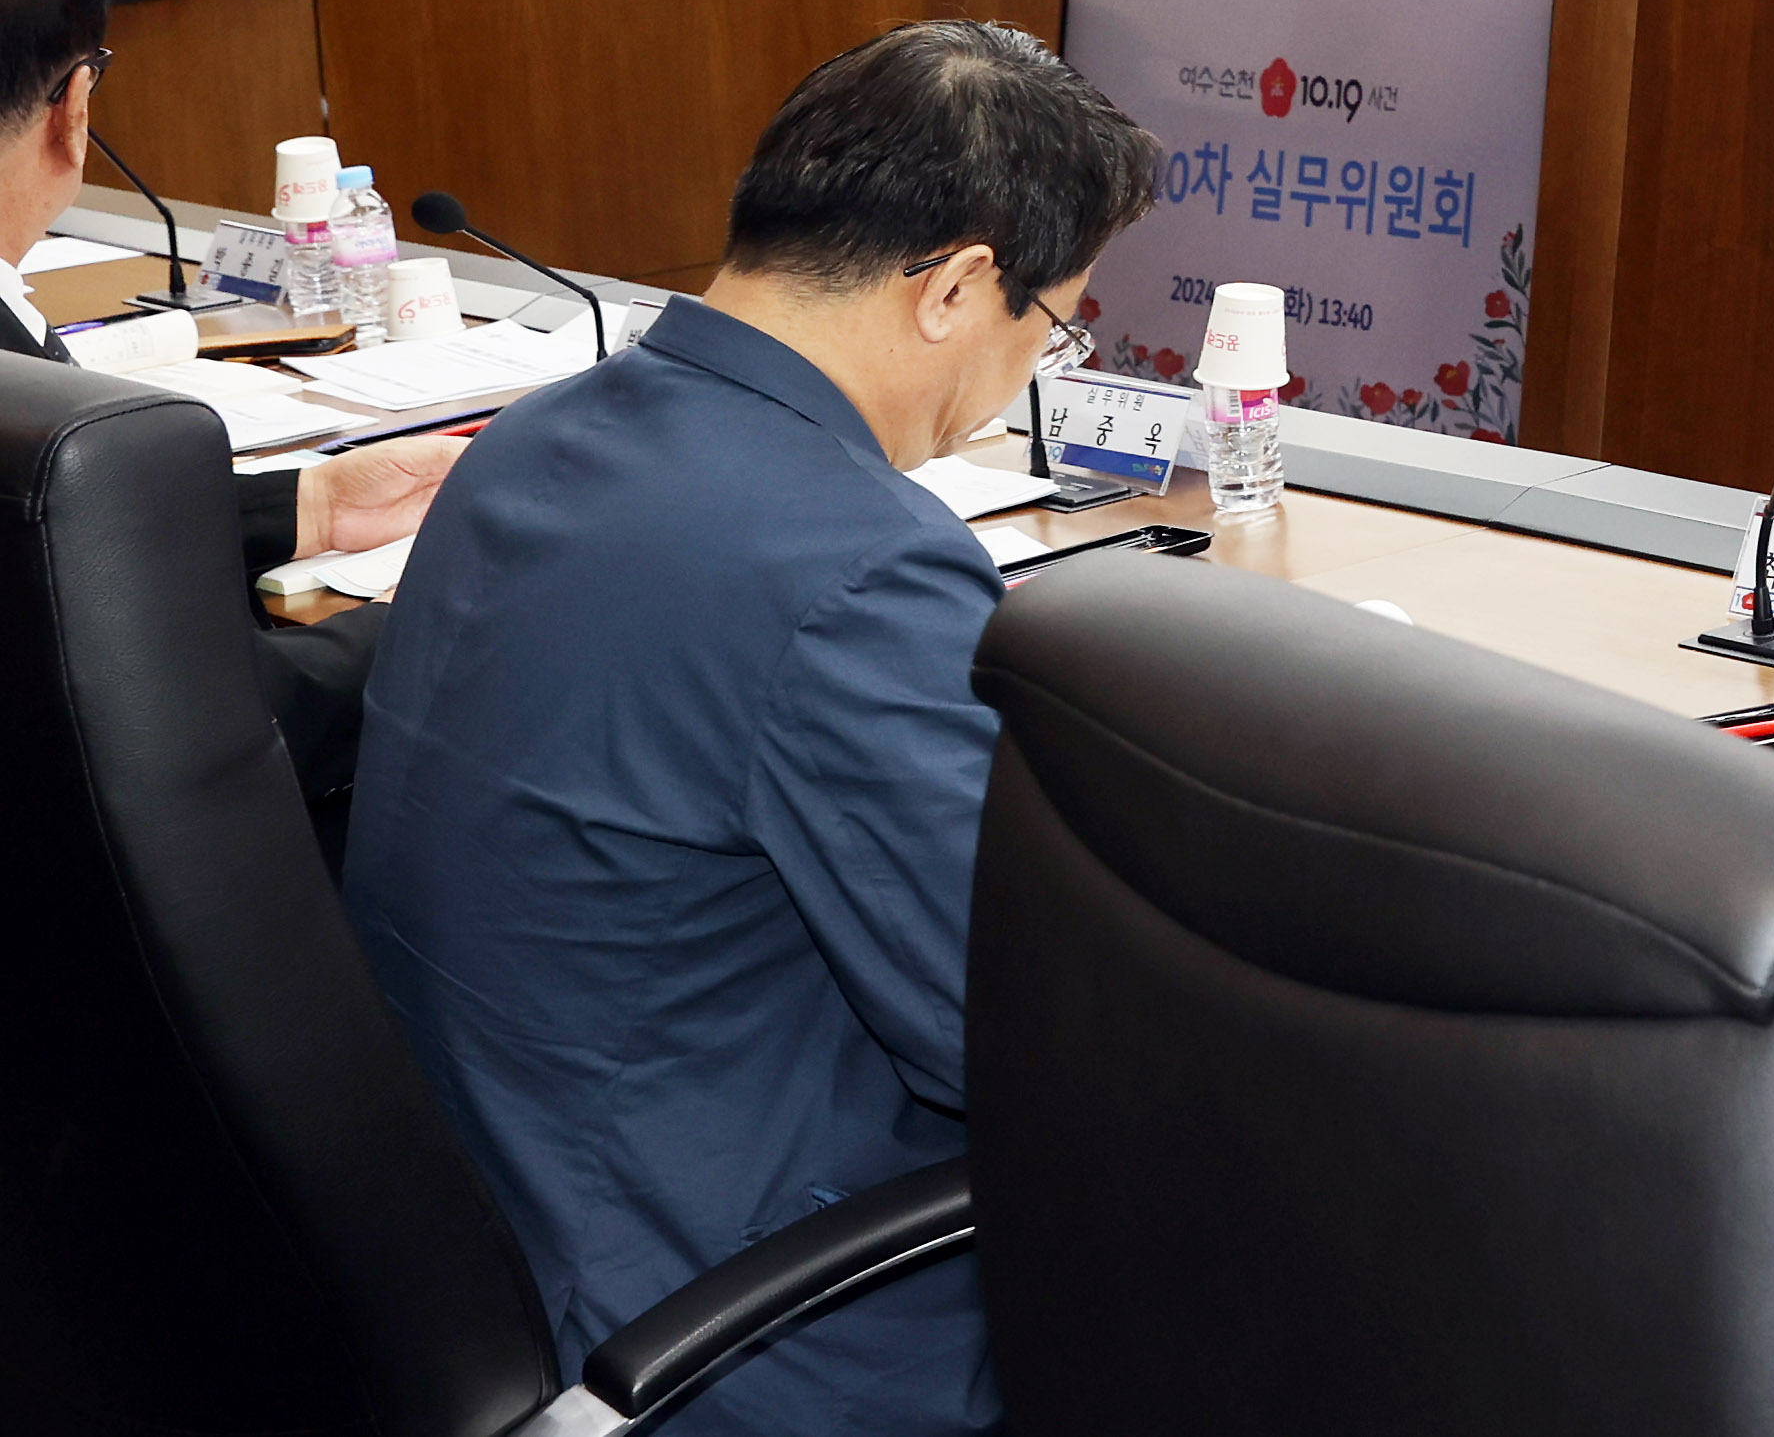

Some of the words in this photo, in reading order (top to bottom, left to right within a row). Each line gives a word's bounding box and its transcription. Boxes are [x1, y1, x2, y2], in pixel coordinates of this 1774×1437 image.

[1301, 75, 1363, 124] 10.19
[1367, 86, 1398, 112] 사건
[1246, 149, 1476, 249] 실무위원회
[1318, 298, 1374, 332] 13:40
